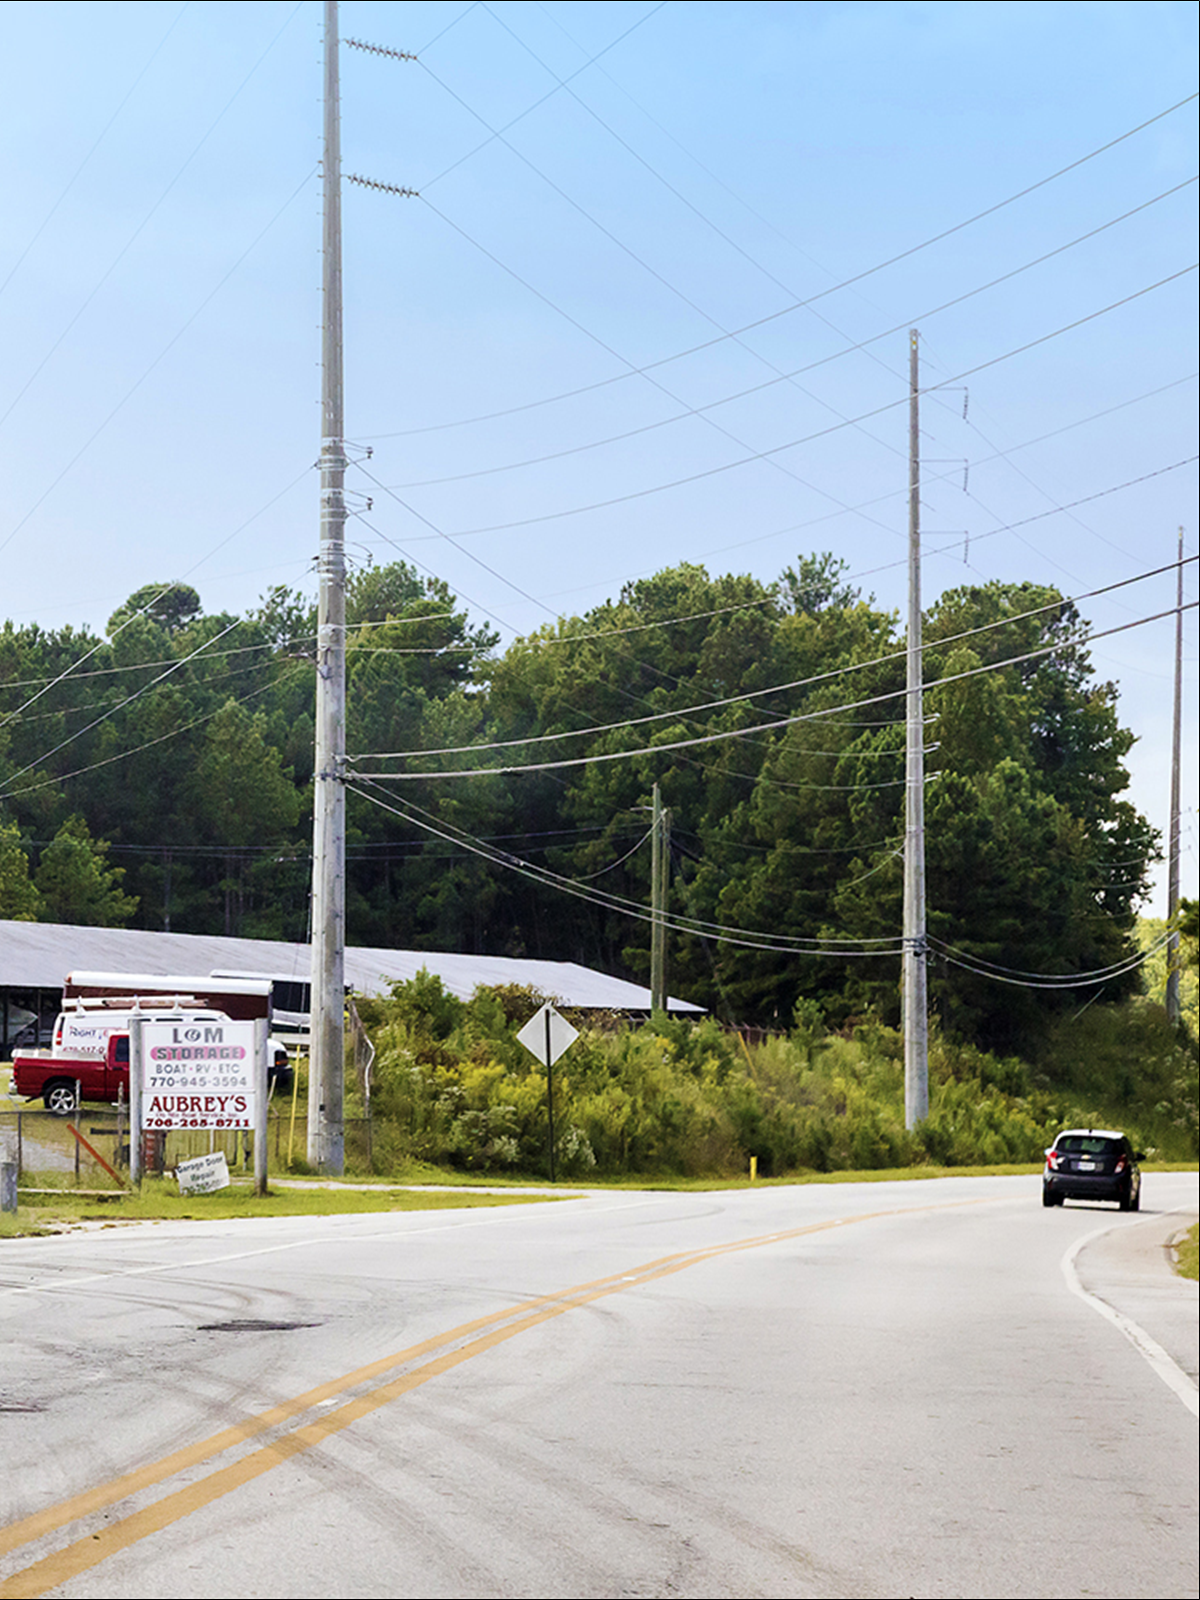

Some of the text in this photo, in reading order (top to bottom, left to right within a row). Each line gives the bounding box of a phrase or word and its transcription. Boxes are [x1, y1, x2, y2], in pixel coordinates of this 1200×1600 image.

[157, 1047, 240, 1060] STORAGE
[155, 1064, 240, 1074] BOAT RV ETC
[150, 1077, 247, 1087] 770-945-3594
[149, 1095, 247, 1112] AUBREY'S
[146, 1118, 249, 1127] 706-265-8711
